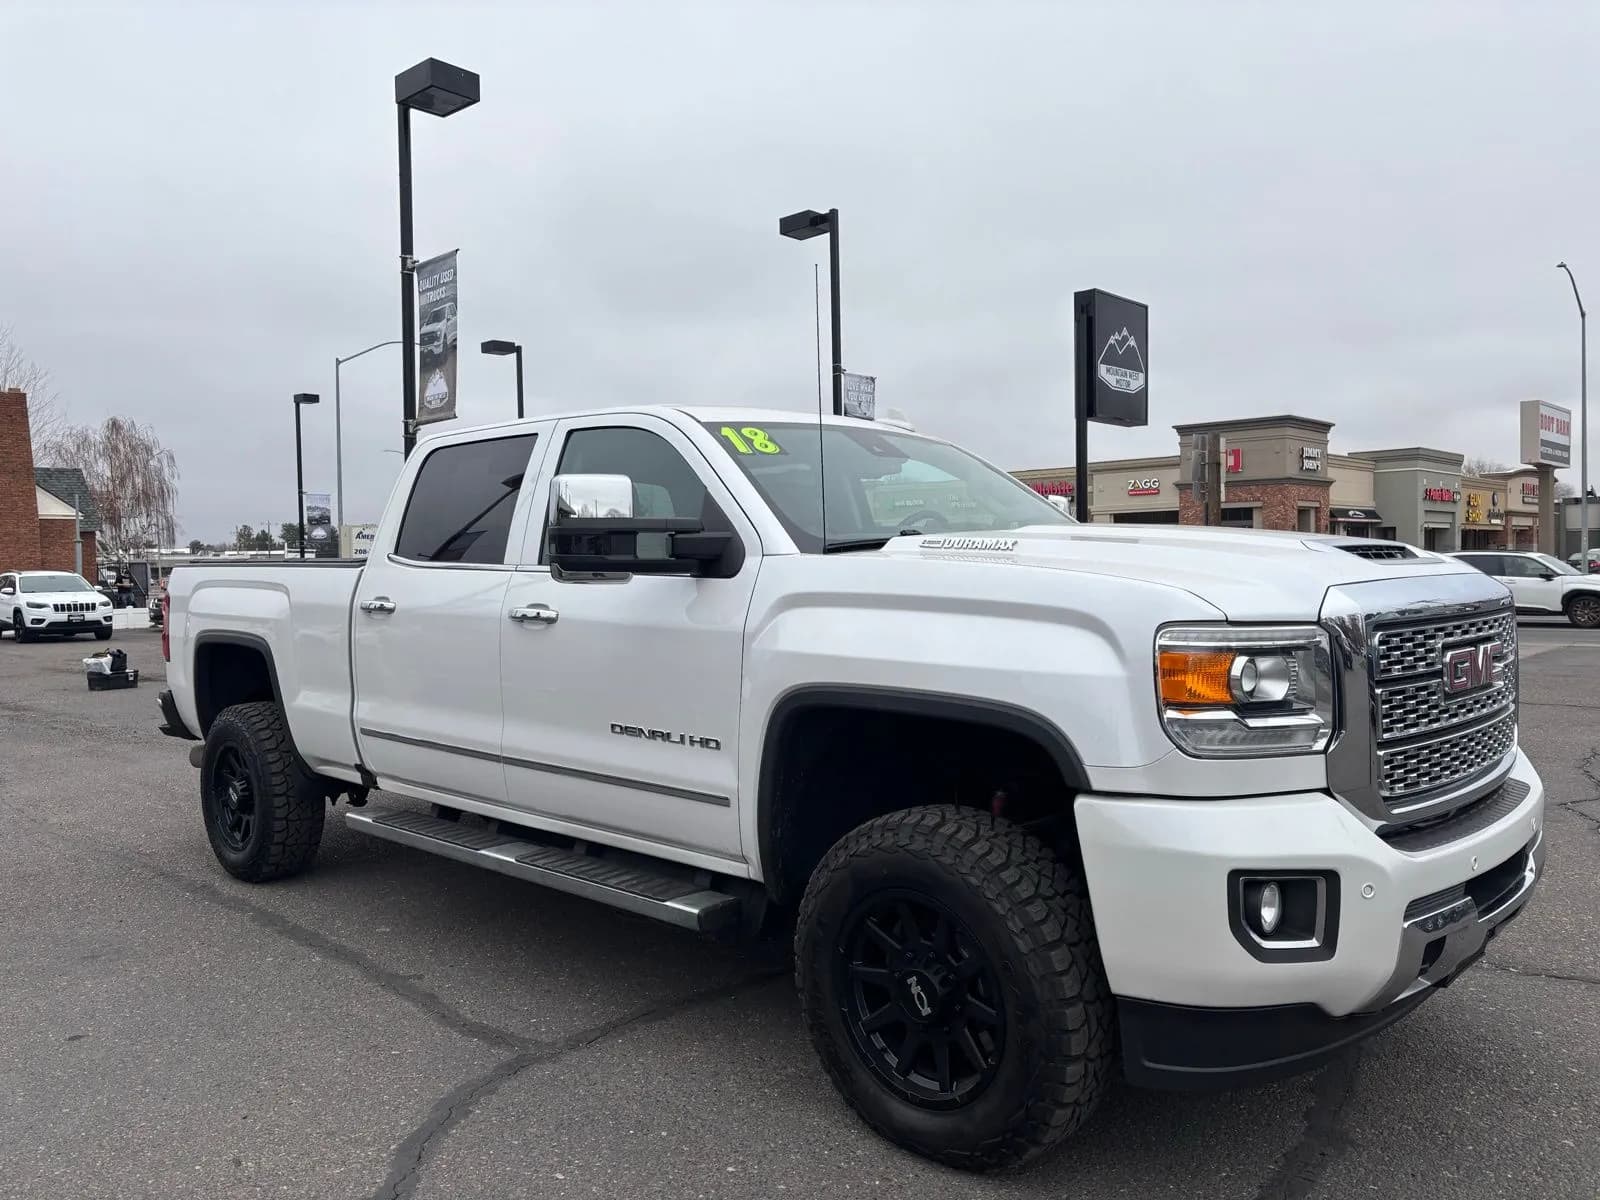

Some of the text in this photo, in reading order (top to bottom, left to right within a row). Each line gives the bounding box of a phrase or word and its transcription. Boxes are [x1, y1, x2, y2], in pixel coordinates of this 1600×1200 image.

[419, 269, 454, 292] QUALITY USED
[427, 286, 446, 303] TRUCKS
[1105, 366, 1140, 381] MOUNTAIN WEST
[847, 380, 860, 391] LOVE
[1115, 378, 1132, 389] MOTOR
[1540, 412, 1555, 433] BOOT
[721, 426, 780, 454] 18
[1303, 447, 1322, 458] JIMMY
[1303, 459, 1321, 471] JOHN'S
[1127, 478, 1160, 490] ZAGG
[940, 538, 1018, 551] DURAMAX
[1445, 641, 1504, 692] GMC
[610, 722, 721, 751] DENALI HD
